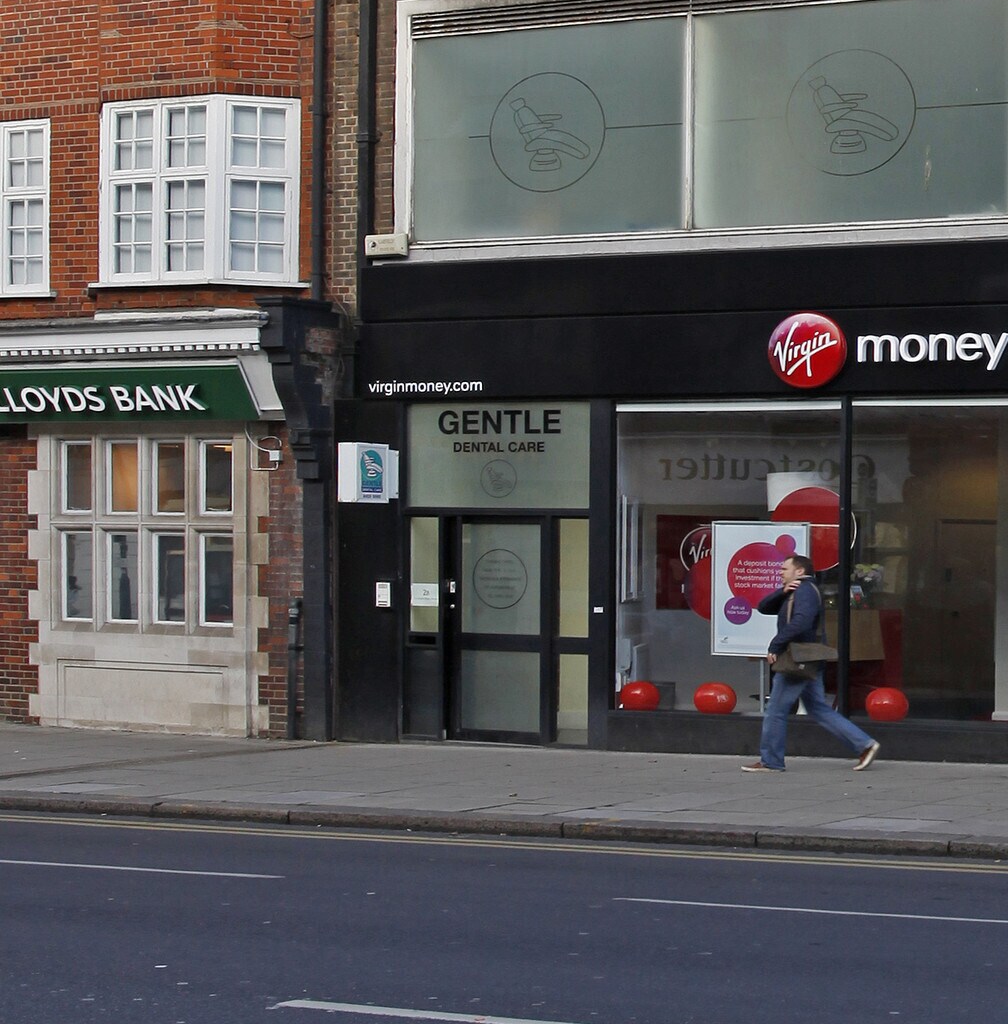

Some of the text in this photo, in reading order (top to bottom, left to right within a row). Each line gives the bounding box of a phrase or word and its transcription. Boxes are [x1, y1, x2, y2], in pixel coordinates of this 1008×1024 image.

[773, 321, 838, 377] Virgin
[110, 384, 208, 412] BANK
[368, 380, 483, 396] virginmoney.com
[438, 409, 562, 435] GENTLE
[453, 441, 545, 453] DENTAL CARE
